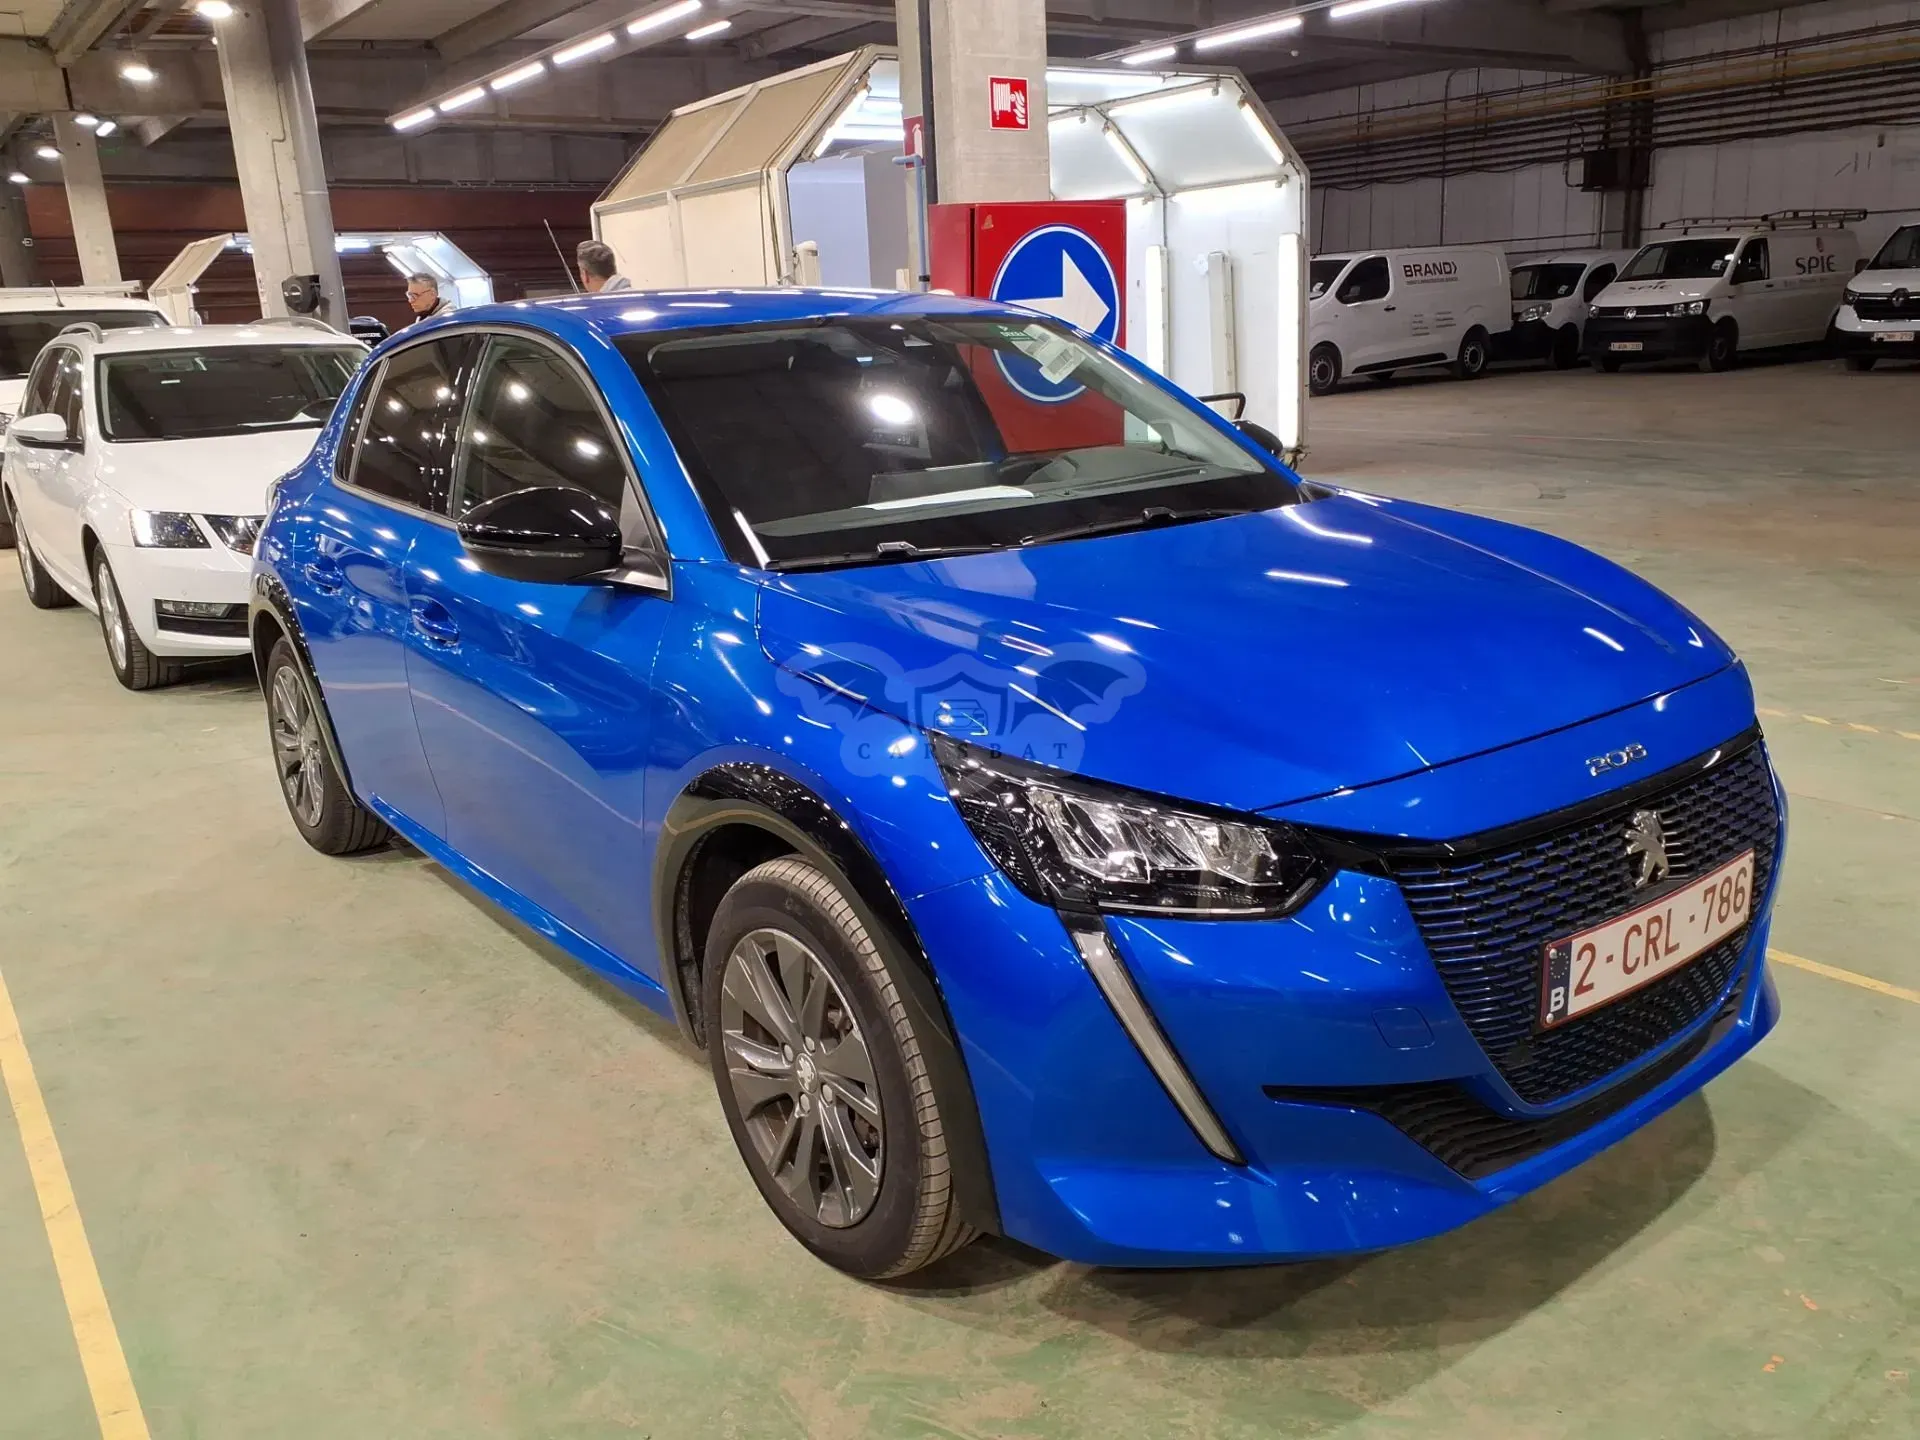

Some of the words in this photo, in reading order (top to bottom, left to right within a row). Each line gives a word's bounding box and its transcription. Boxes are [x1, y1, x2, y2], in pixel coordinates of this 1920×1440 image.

[1585, 743, 1647, 776] 208
[1574, 866, 1748, 995] 2-CRL-786
[1550, 988, 1565, 1012] B
